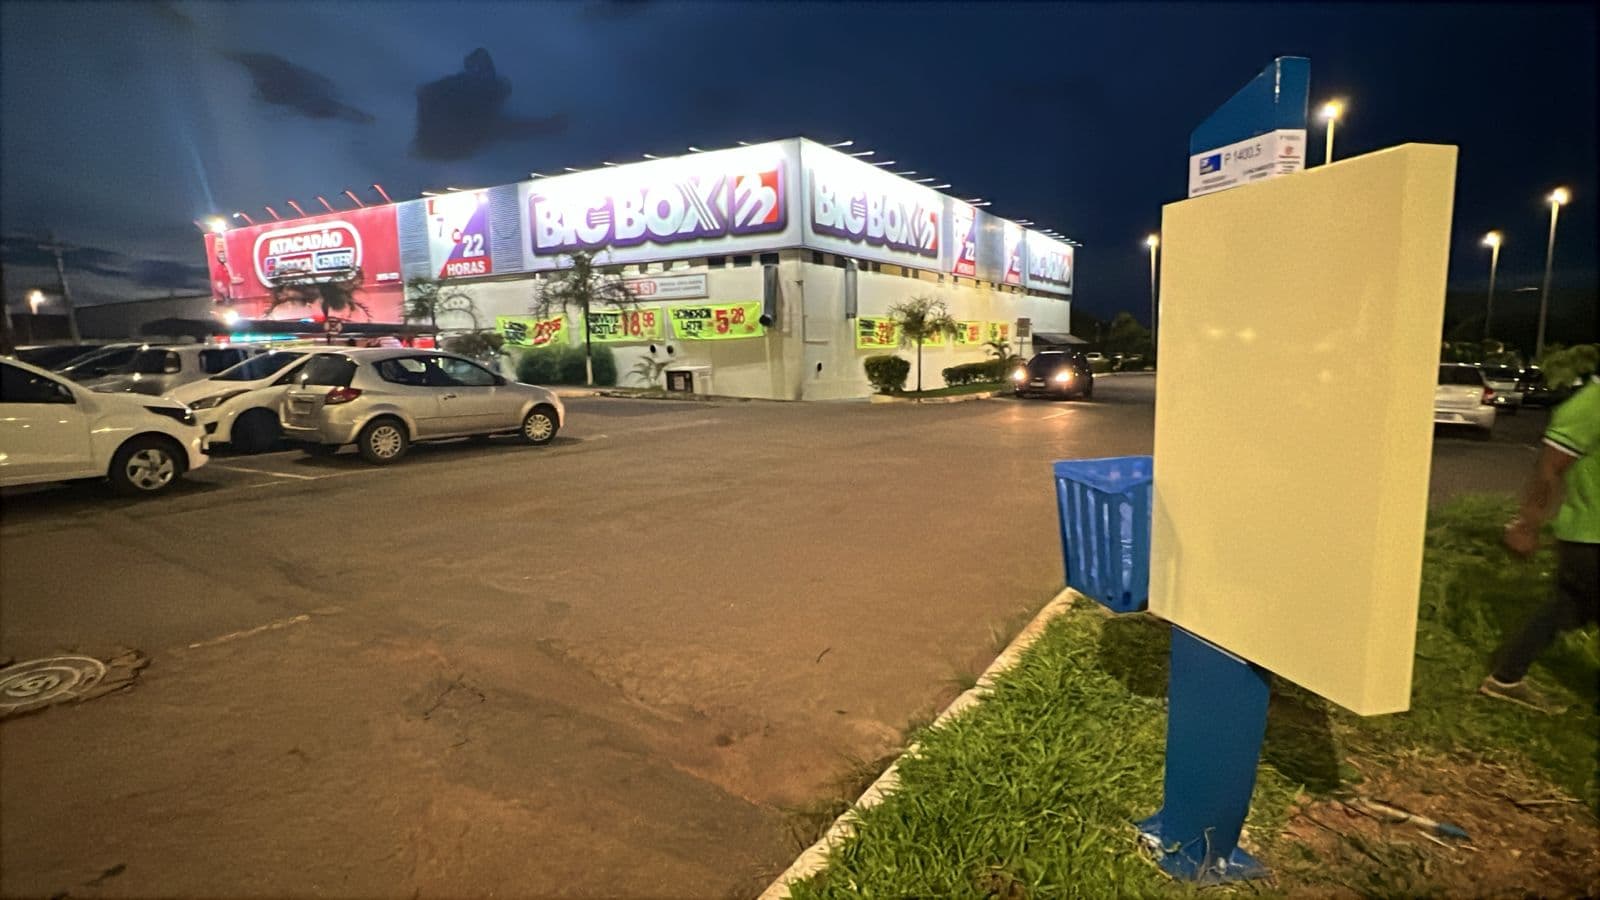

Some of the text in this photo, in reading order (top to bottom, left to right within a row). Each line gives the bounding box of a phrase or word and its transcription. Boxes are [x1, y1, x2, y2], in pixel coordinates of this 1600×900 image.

[534, 193, 611, 249] BIG
[612, 174, 727, 241] BOX
[815, 177, 866, 234] BIG
[866, 192, 918, 247] BOX
[269, 229, 344, 257] ATACADÃO
[462, 233, 486, 259] 22
[446, 260, 487, 277] HORAS
